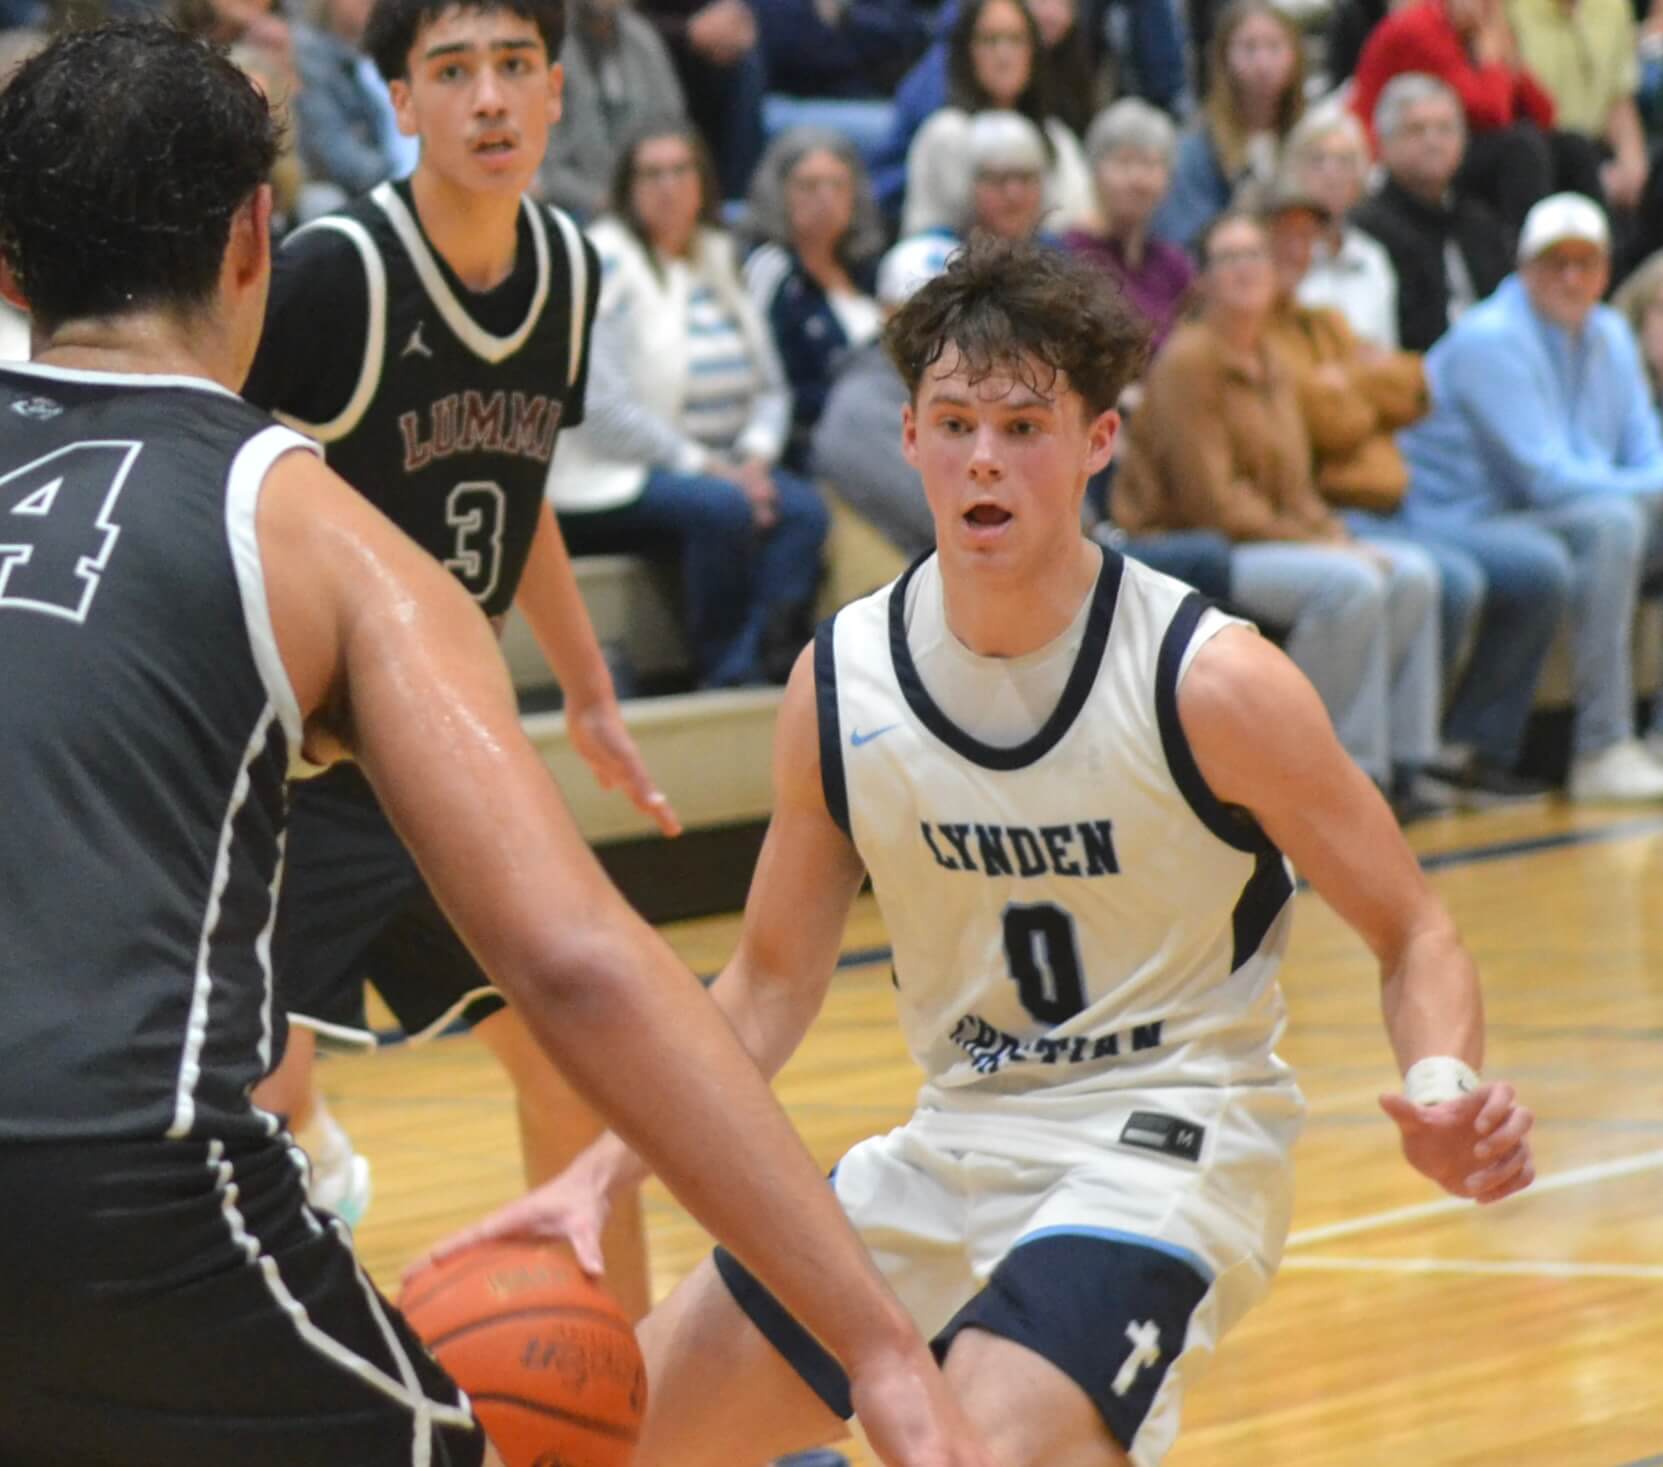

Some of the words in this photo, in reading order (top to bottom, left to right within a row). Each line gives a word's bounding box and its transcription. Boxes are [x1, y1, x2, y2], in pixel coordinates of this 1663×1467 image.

[398, 390, 563, 473] LUMMI
[0, 440, 144, 624] 4
[444, 480, 505, 603] 3
[920, 819, 1120, 878] LYNDEN
[1001, 899, 1090, 1028] 0
